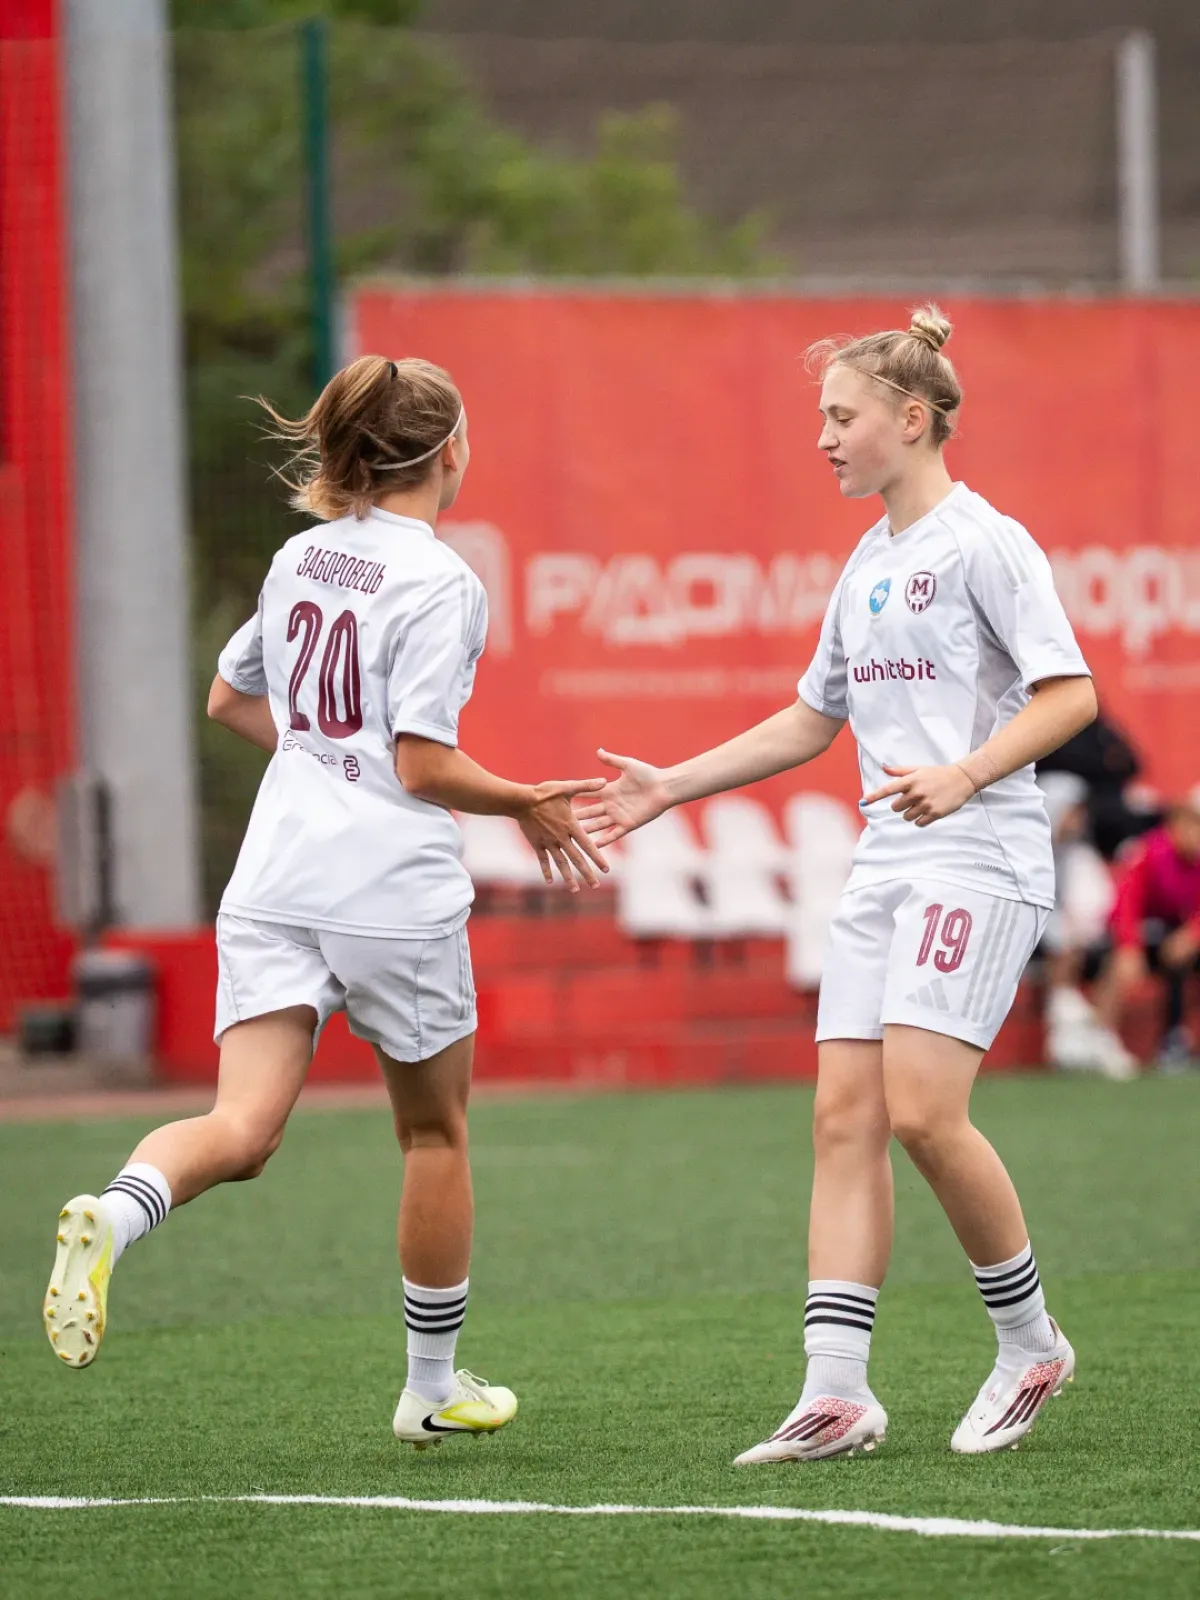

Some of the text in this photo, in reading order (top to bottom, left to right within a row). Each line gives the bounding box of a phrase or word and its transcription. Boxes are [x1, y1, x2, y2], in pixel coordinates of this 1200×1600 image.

[296, 545, 386, 595] ЗАБОРОВЕЦЬ
[286, 600, 363, 739] 20
[916, 903, 973, 973] 19
